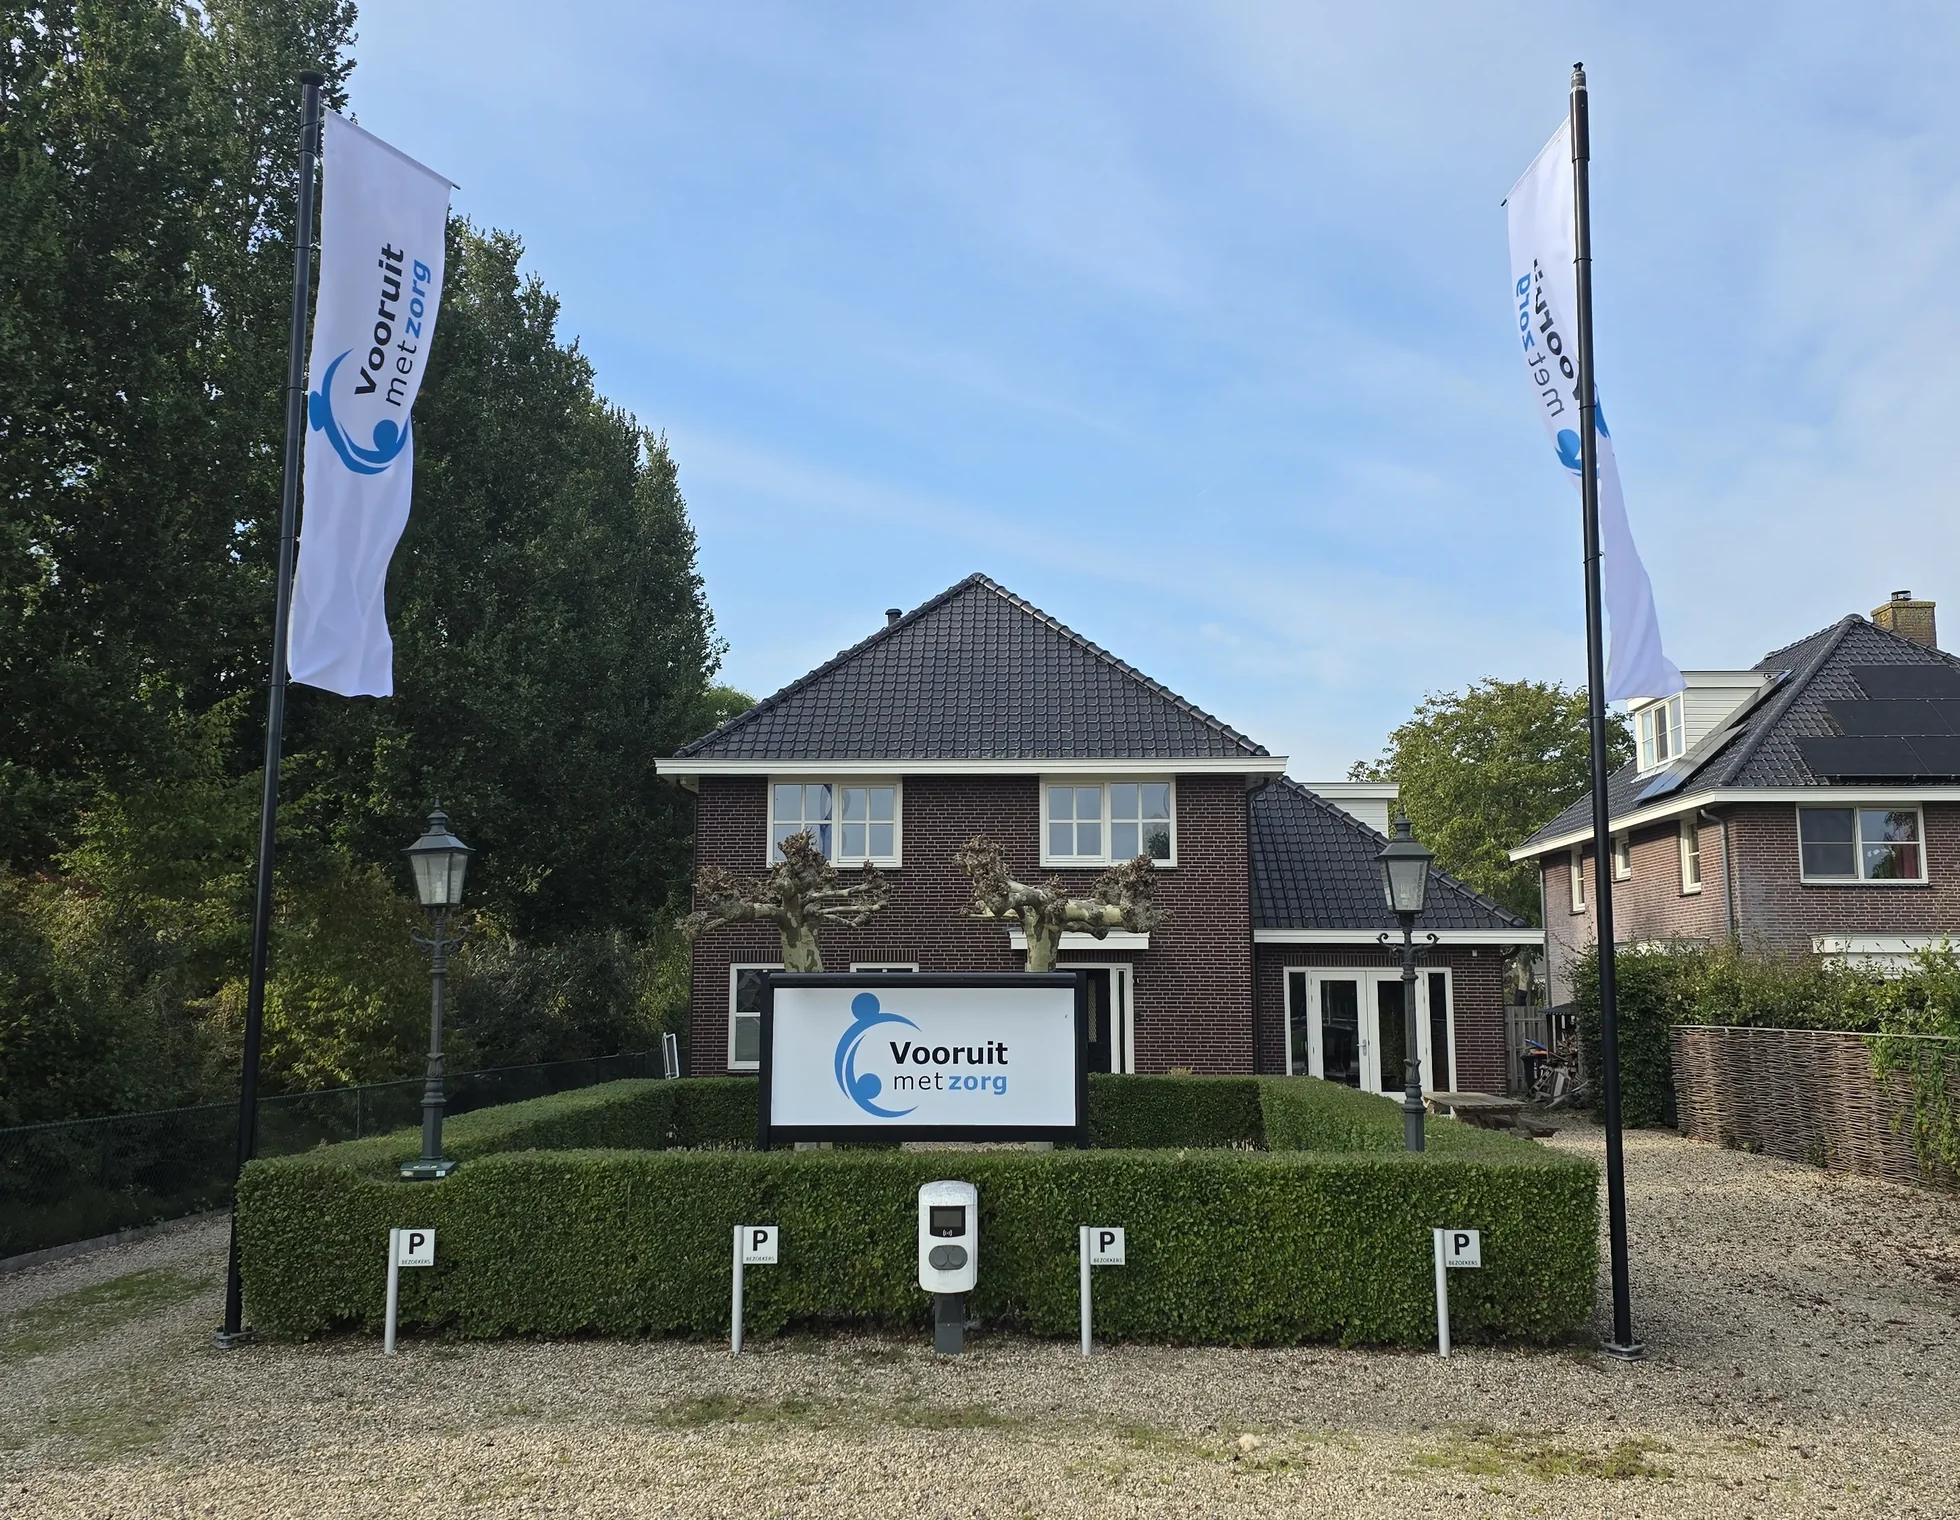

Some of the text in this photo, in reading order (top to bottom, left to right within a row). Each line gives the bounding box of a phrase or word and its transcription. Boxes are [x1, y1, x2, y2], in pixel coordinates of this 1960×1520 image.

[354, 243, 404, 395] Vooruit
[385, 259, 431, 407] met zorg
[889, 1041, 1009, 1065] Vooruit
[893, 1072, 1007, 1096] met zorg
[408, 1232, 425, 1255] P
[752, 1229, 769, 1252] P
[1099, 1231, 1116, 1253] P
[1454, 1233, 1470, 1256] P
